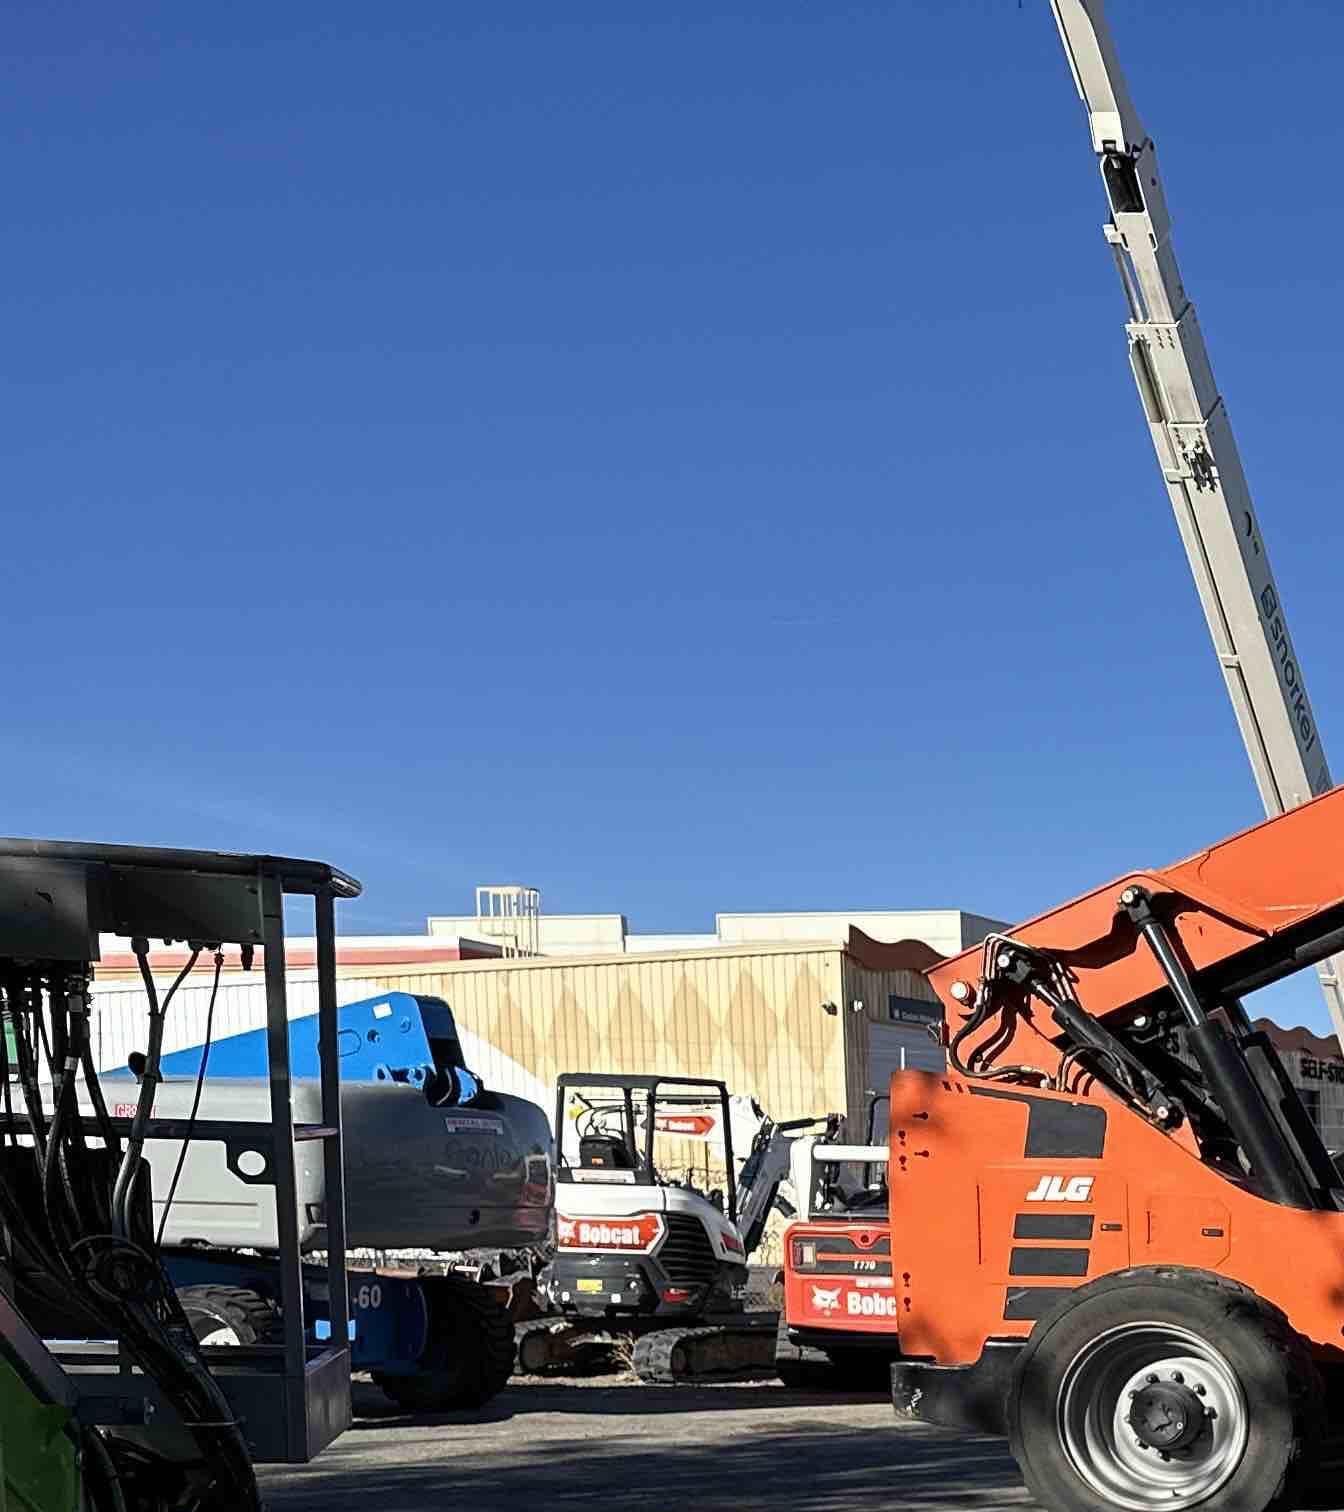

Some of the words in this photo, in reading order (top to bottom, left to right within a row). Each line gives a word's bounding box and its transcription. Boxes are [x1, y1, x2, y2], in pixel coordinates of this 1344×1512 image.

[1269, 616, 1316, 753] snorkel
[1026, 1175, 1096, 1202] JLG
[579, 1222, 640, 1246] Bobcat
[847, 1290, 896, 1317] Bobc
